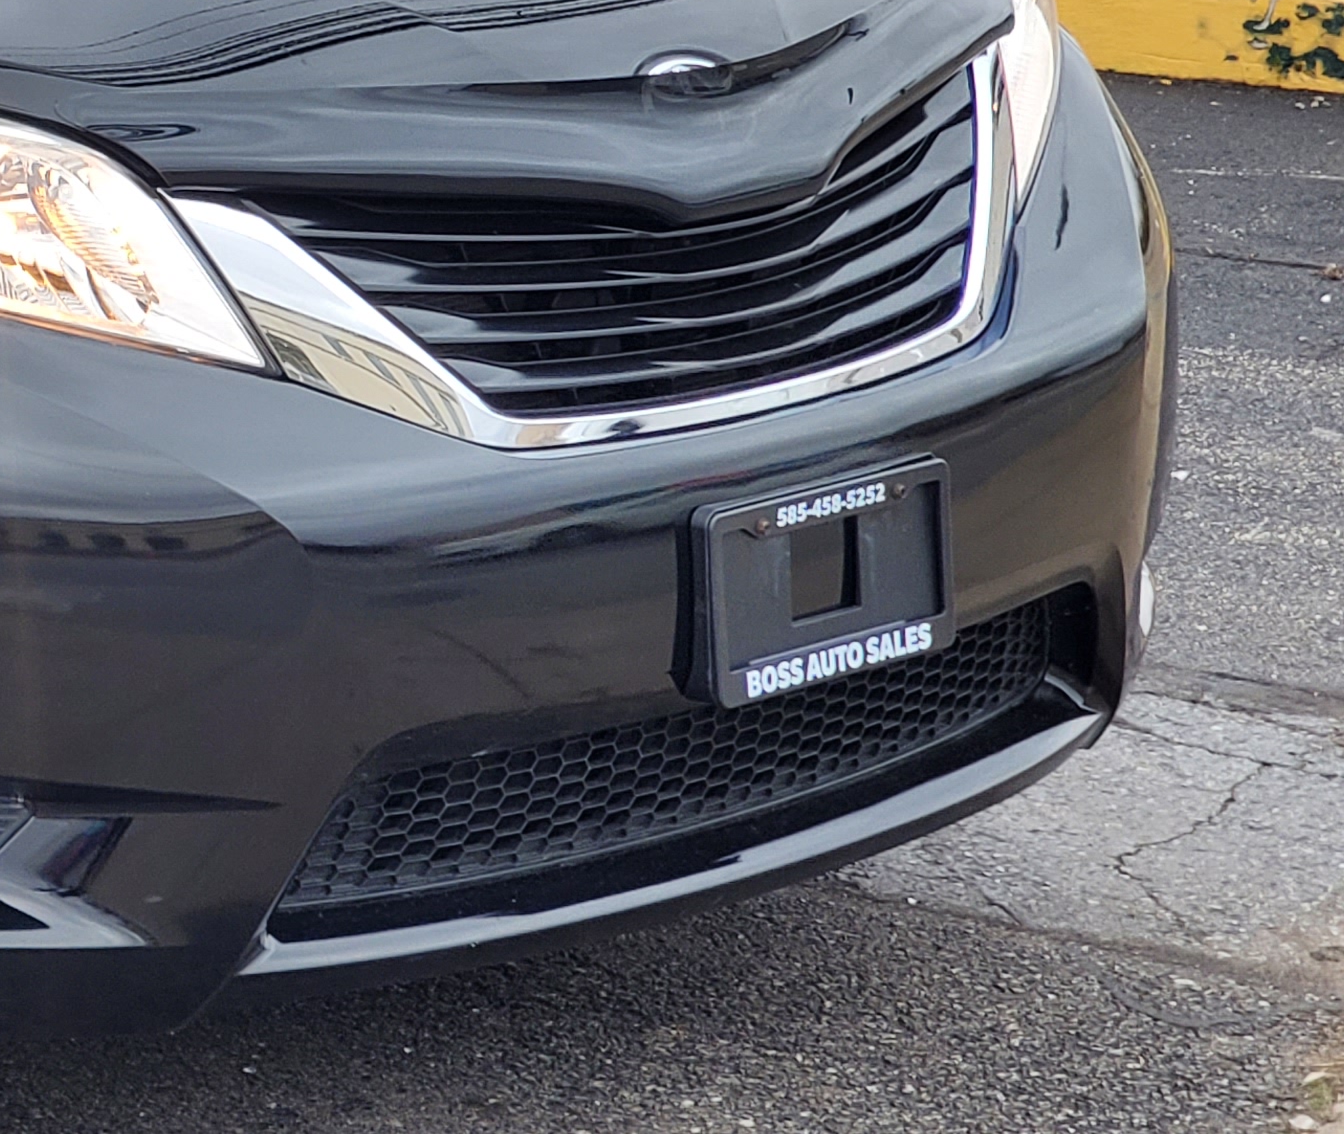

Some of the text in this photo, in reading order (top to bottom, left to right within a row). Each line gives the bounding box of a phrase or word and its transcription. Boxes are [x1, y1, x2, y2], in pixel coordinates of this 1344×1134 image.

[775, 482, 886, 528] 585-458-5252
[745, 622, 933, 699] BOSS AUTO SALES
